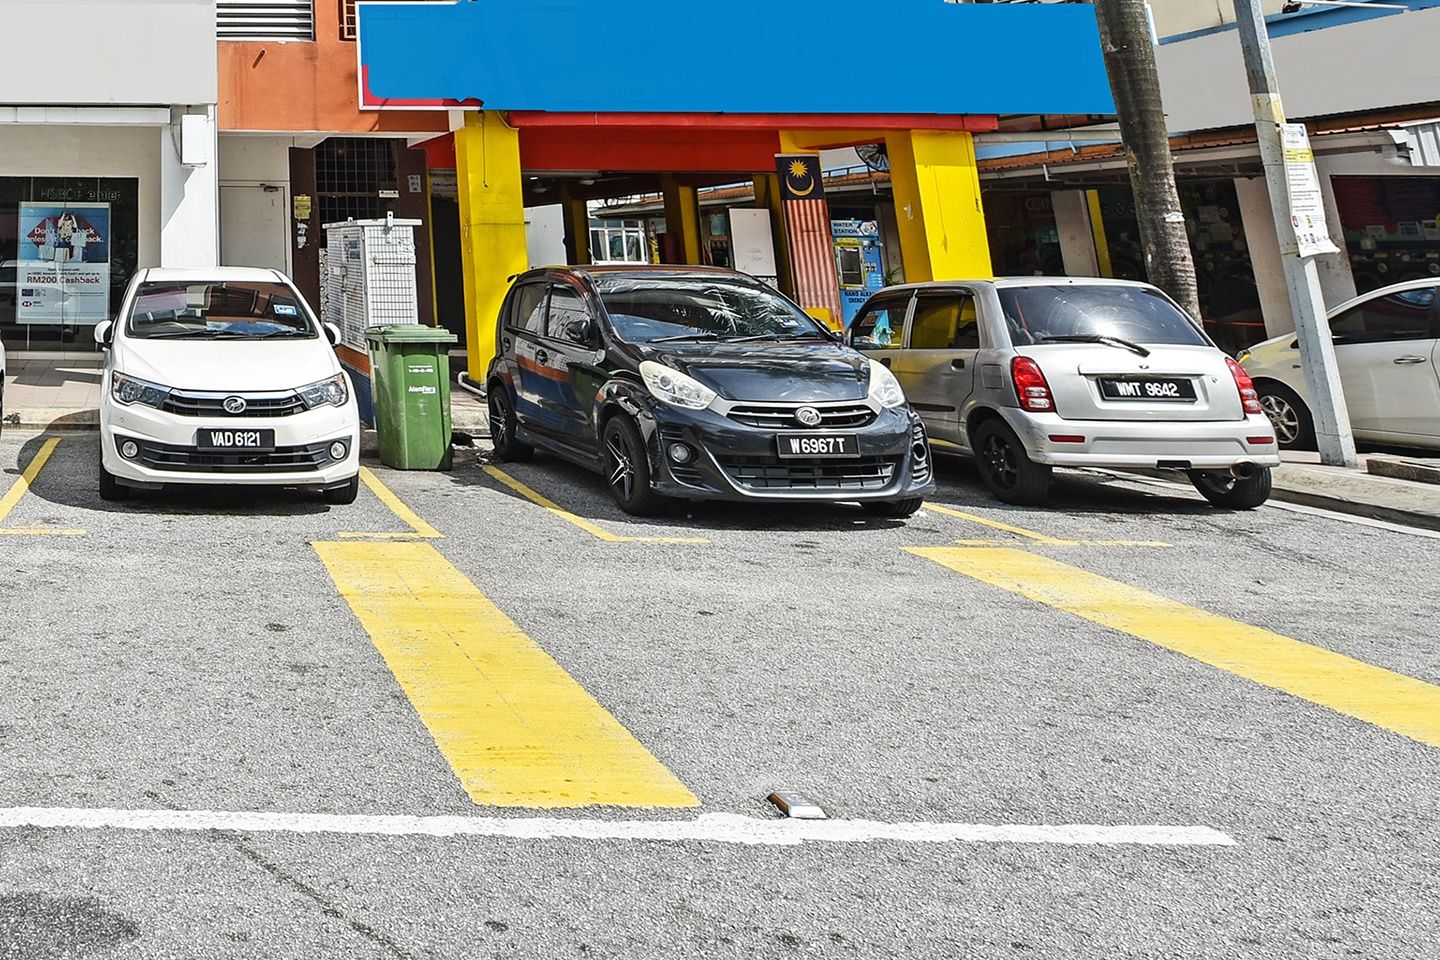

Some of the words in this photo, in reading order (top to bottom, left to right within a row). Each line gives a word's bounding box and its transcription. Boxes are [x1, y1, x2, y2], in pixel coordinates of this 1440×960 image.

[26, 276, 58, 284] RM200
[60, 276, 101, 284] Cashback
[1116, 382, 1142, 396] WMT
[1145, 382, 1180, 396] 9642
[211, 431, 233, 446] VAD
[235, 431, 261, 446] 6121
